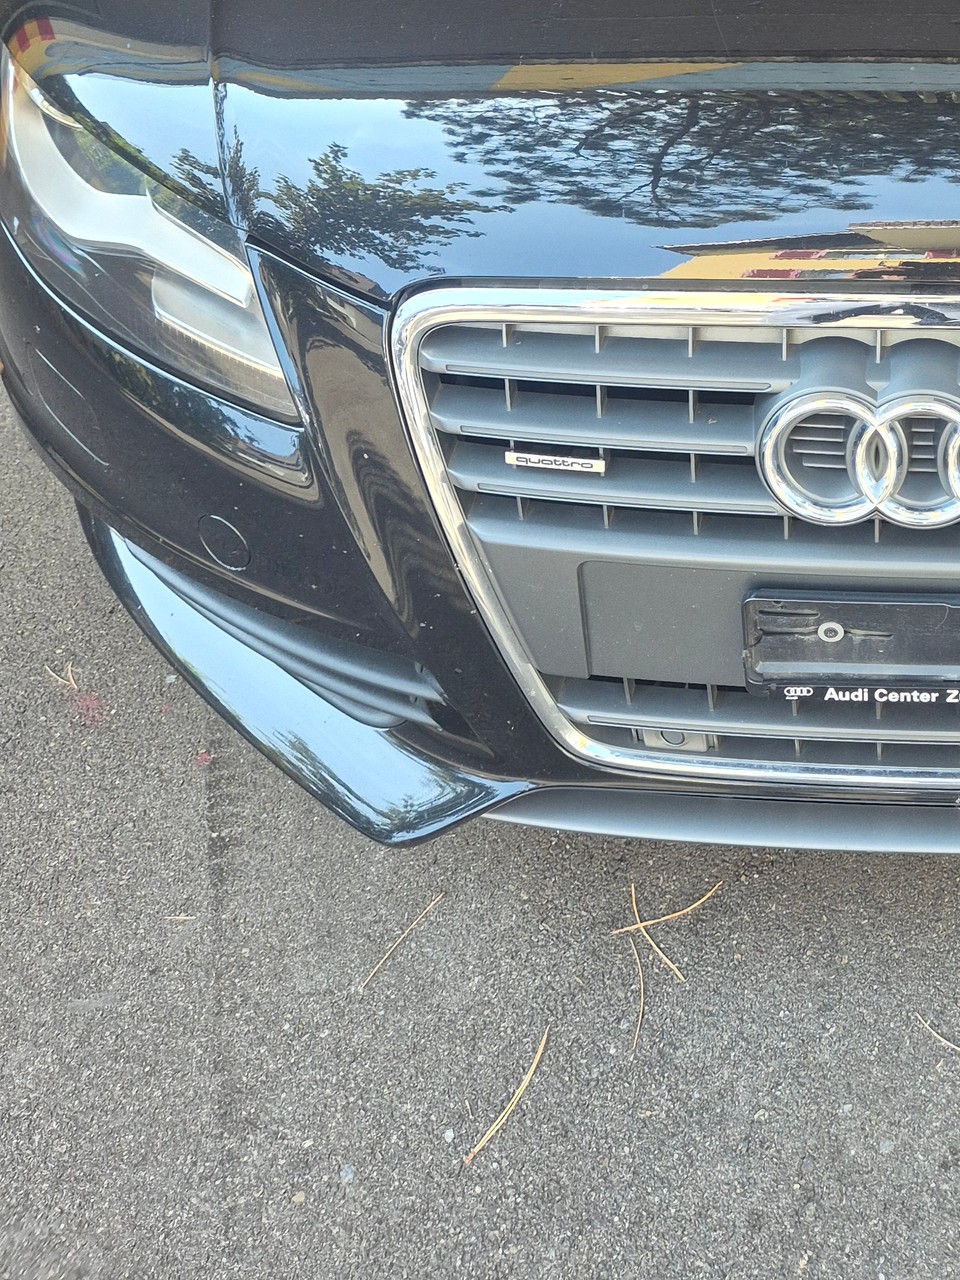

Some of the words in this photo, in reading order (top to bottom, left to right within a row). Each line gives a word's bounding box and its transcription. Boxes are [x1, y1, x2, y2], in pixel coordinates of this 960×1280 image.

[516, 456, 594, 469] quattro
[823, 687, 869, 702] Audi
[873, 688, 940, 703] Center
